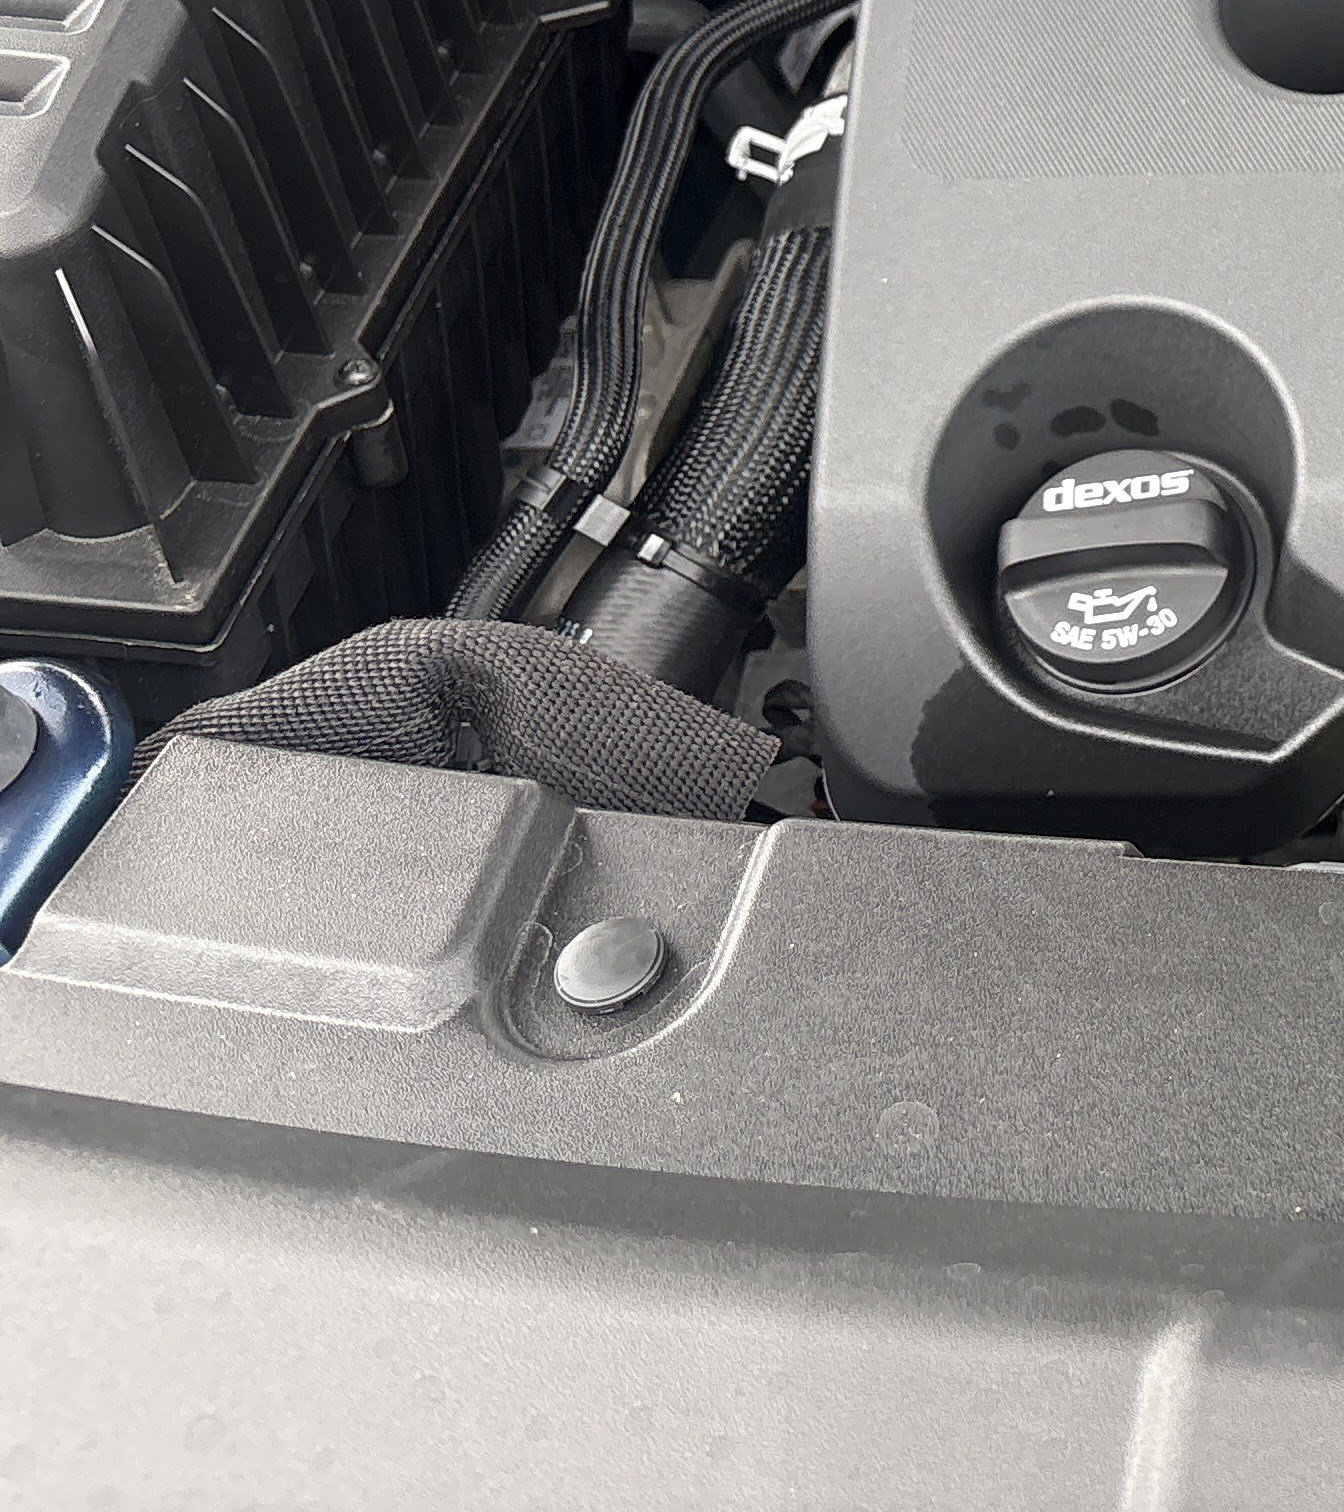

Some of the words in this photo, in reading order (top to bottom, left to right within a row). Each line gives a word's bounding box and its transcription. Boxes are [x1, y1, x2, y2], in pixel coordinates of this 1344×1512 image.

[1042, 469, 1194, 513] dexos
[1050, 620, 1096, 651] SAE
[1100, 608, 1178, 651] 5W-30
